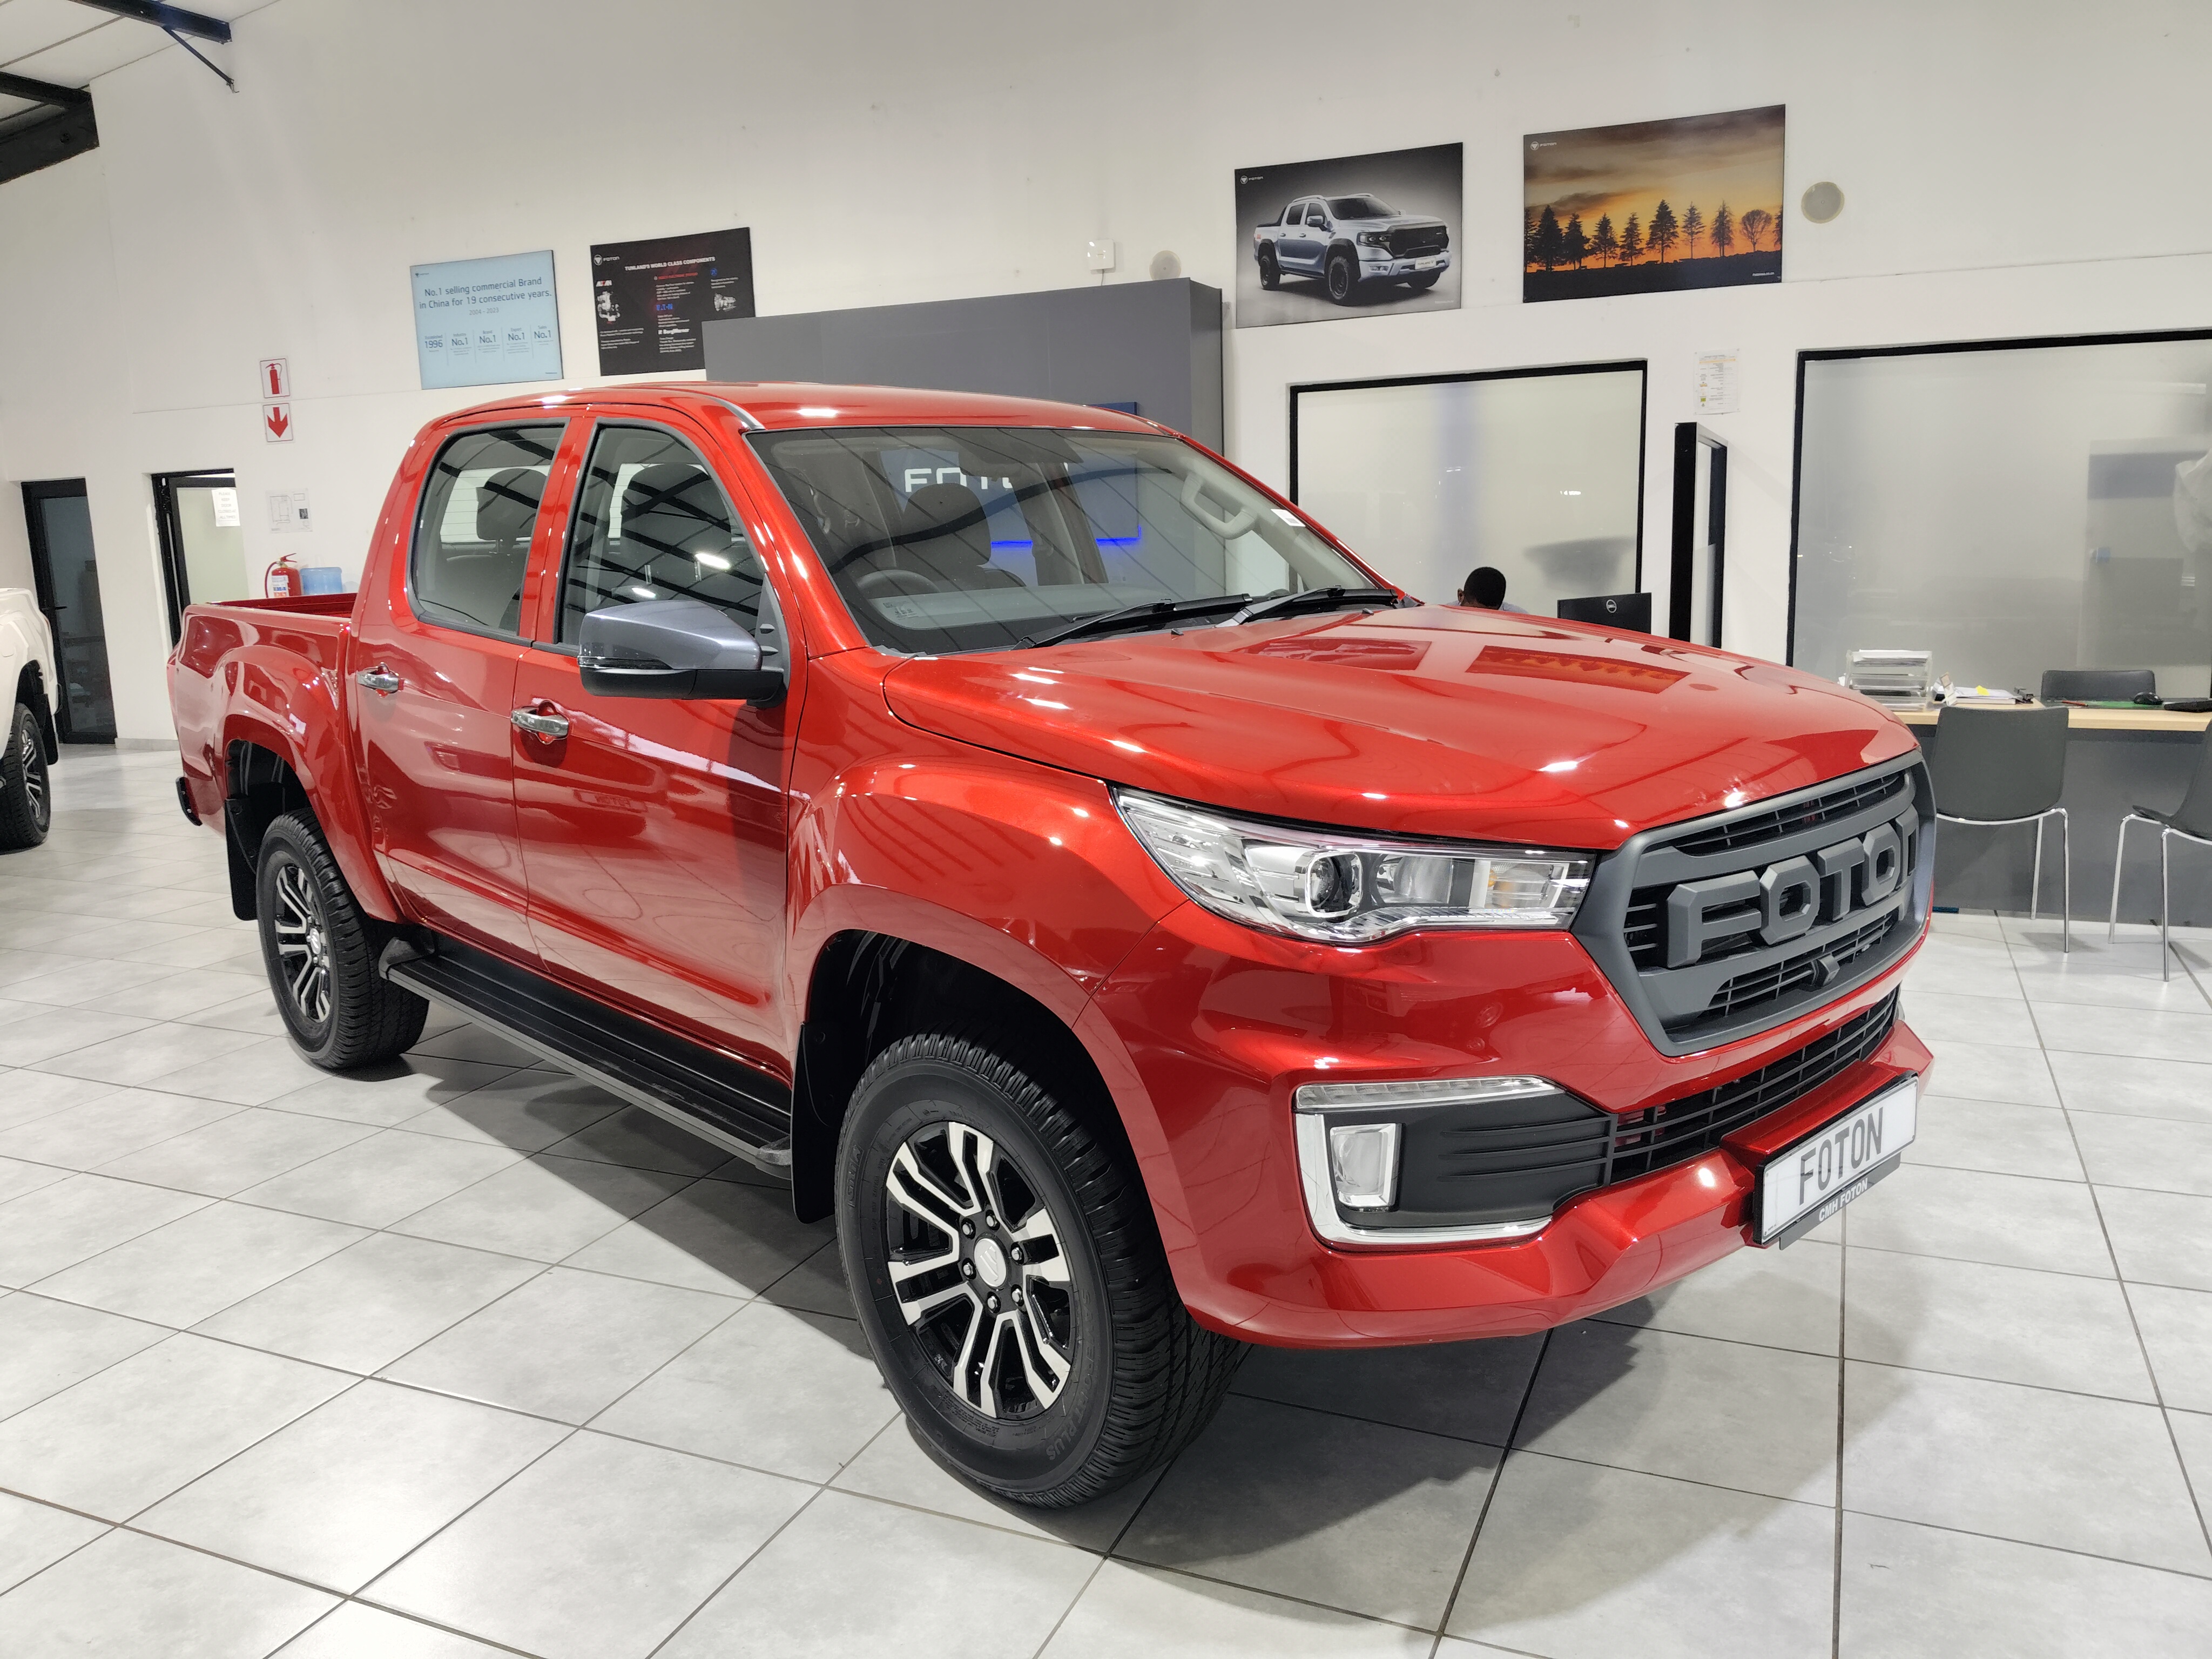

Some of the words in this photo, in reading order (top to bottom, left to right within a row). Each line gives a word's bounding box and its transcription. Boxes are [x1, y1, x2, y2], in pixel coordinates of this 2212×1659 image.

[683, 257, 716, 265] COMPONENTS
[424, 287, 442, 296] No.1
[446, 286, 470, 295] selling
[471, 280, 516, 292] commercial
[518, 276, 542, 287] Brand
[419, 301, 427, 309] in
[428, 299, 450, 309] China
[451, 298, 463, 306] for
[466, 296, 476, 305] 19
[478, 292, 525, 304] consecutive
[527, 289, 552, 300] years.
[479, 335, 497, 343] No.1
[508, 332, 525, 341] No.1
[534, 330, 551, 339] No.1
[424, 340, 443, 349] 1996
[451, 337, 469, 346] No.1
[1799, 1107, 1884, 1206] FOTON
[1818, 1198, 1839, 1222] CMH
[1839, 1177, 1868, 1208] FOTON
[1046, 1419, 1078, 1461] PLUS
